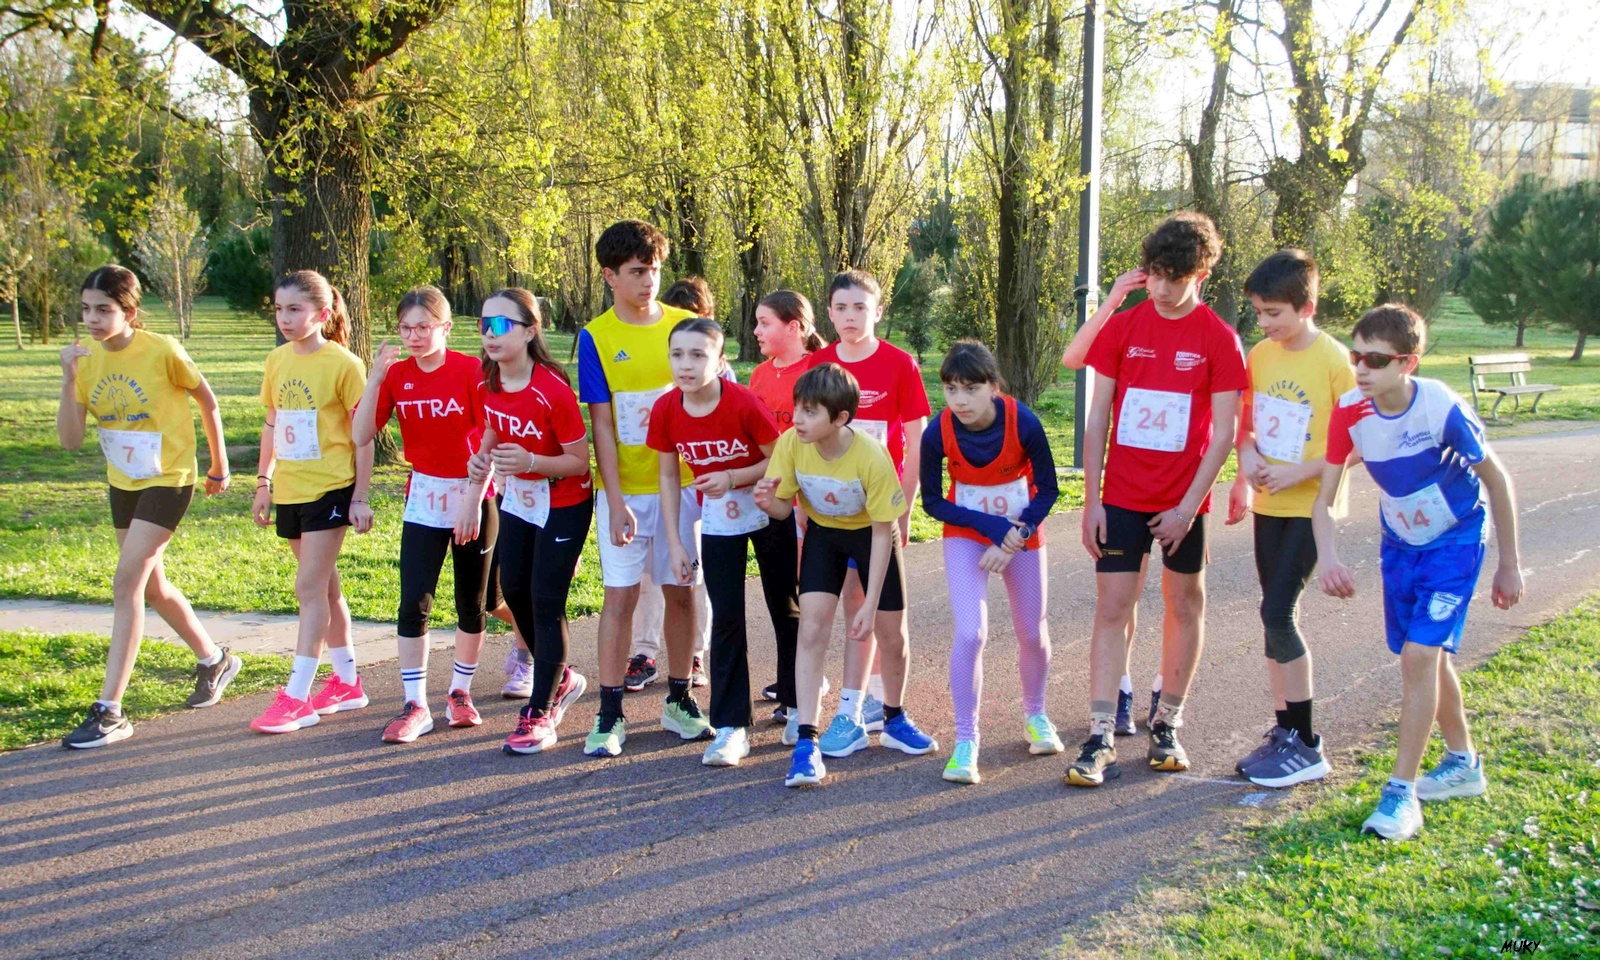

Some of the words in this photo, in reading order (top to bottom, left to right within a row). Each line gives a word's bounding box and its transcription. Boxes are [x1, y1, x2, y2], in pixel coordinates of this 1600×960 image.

[1137, 407, 1168, 432] 24
[1266, 415, 1280, 439] 2
[285, 425, 296, 445] 6
[122, 445, 135, 463] 7
[426, 490, 449, 513] 11
[824, 491, 839, 506] 4
[978, 495, 1009, 516] 19
[725, 500, 740, 520] 8
[1396, 508, 1431, 531] 14
